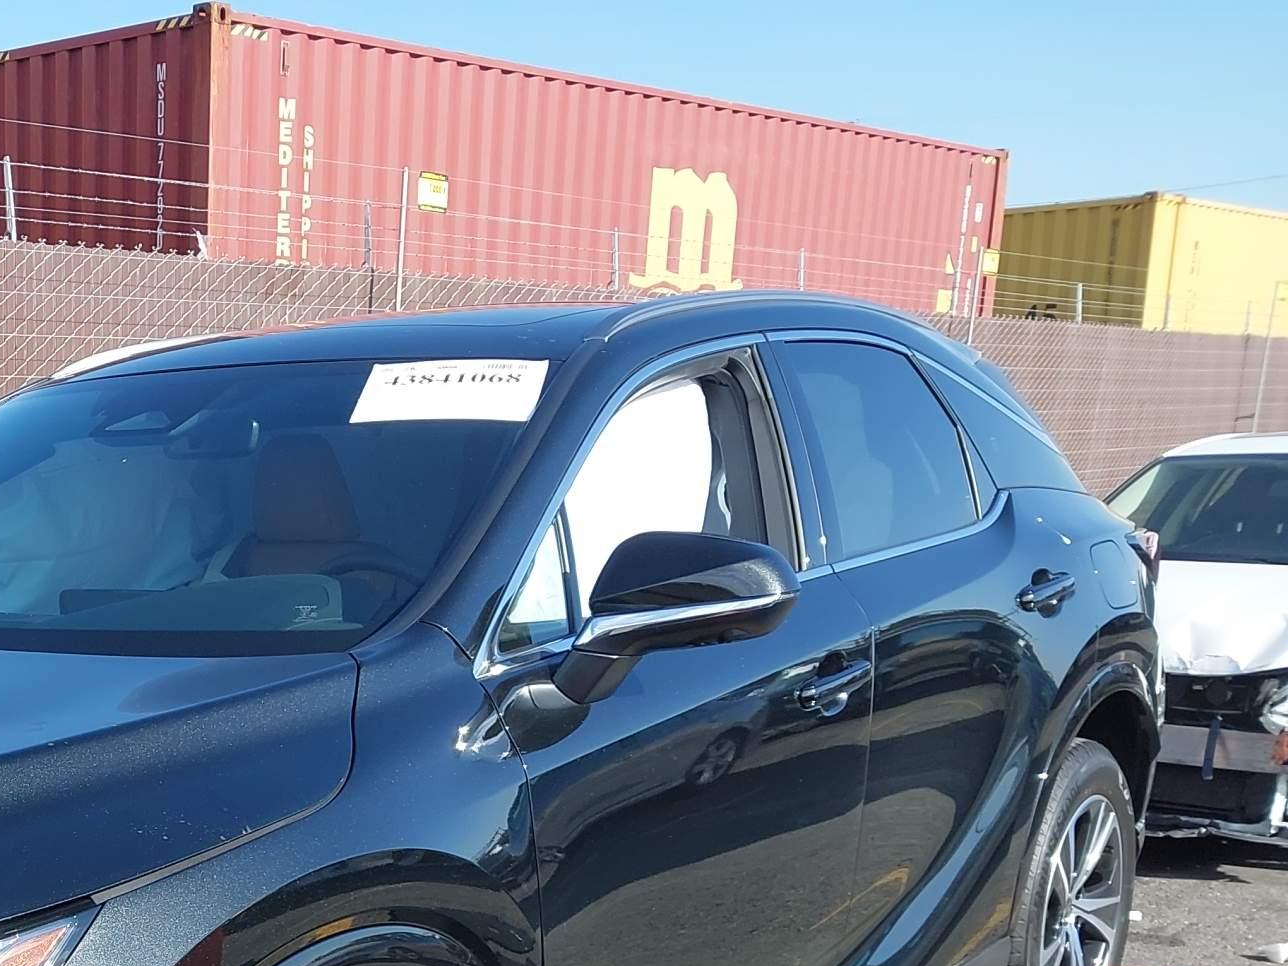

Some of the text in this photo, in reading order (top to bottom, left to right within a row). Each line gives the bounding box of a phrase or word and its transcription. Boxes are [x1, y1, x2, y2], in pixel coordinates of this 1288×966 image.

[156, 62, 167, 136] MSDU
[300, 125, 315, 265] SHIPPI
[383, 373, 523, 386] 43841068
